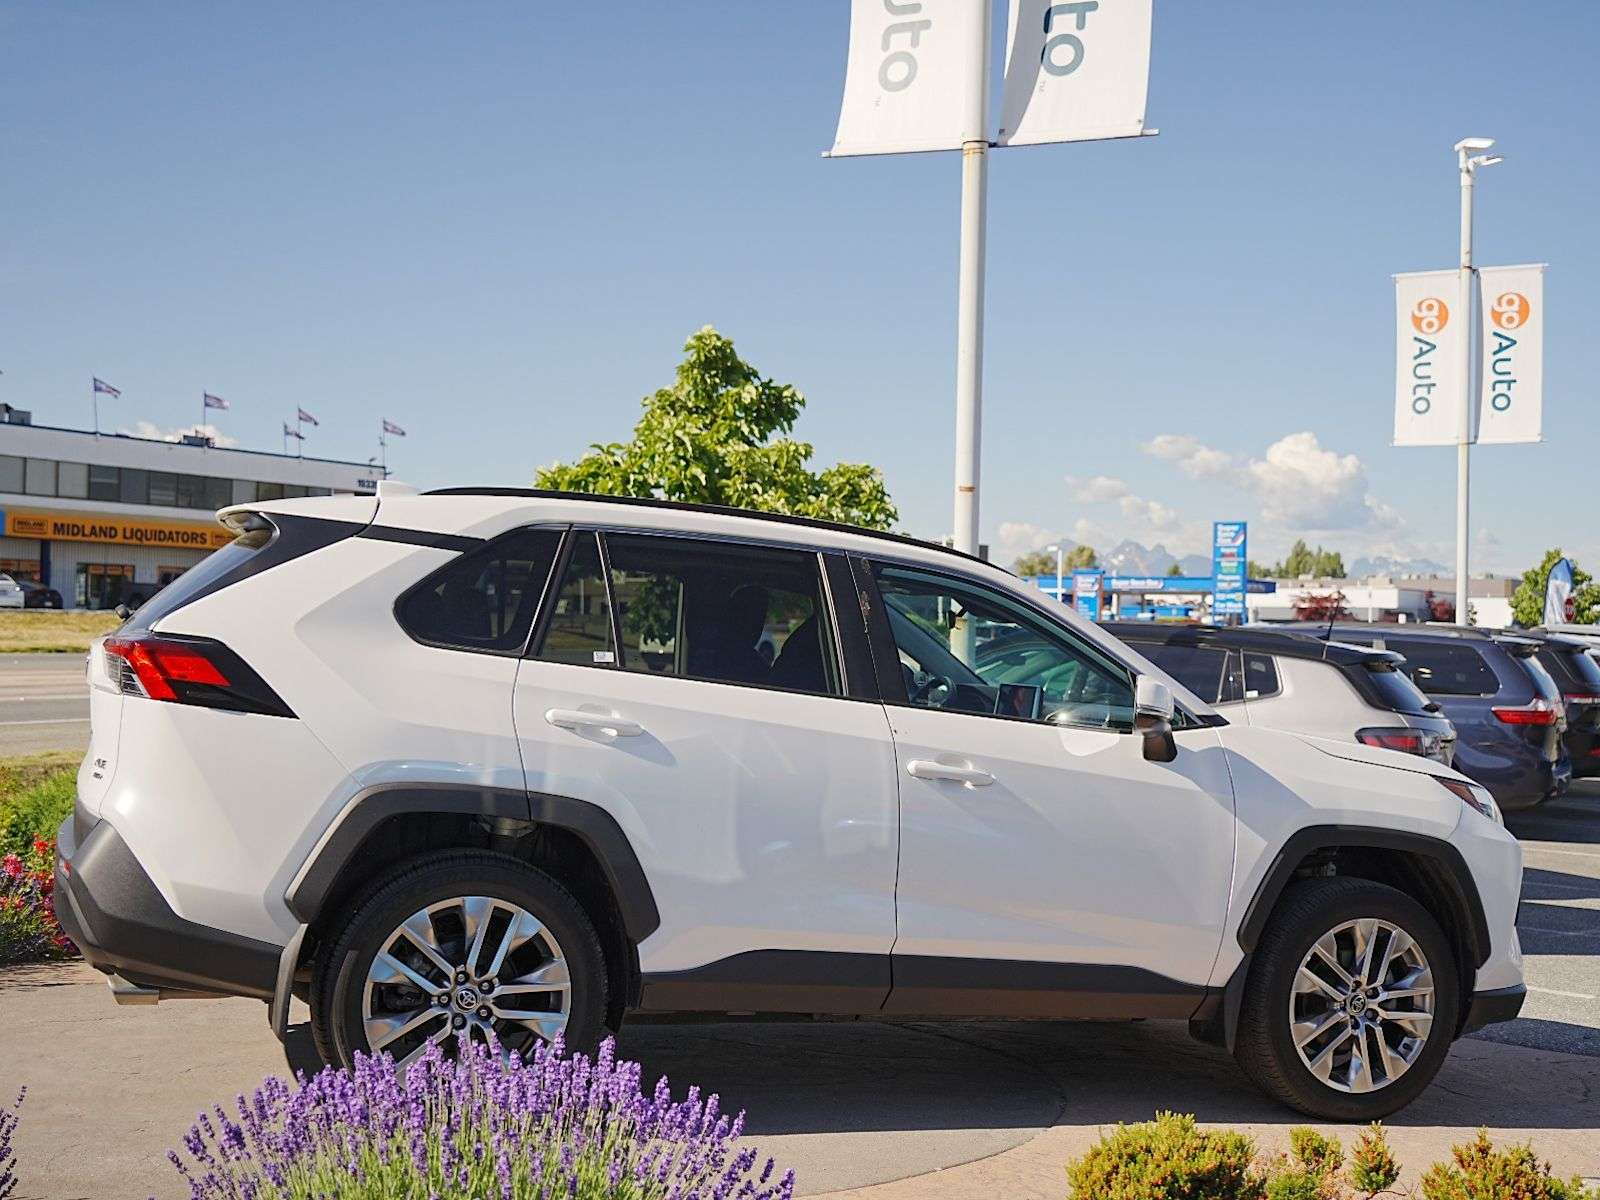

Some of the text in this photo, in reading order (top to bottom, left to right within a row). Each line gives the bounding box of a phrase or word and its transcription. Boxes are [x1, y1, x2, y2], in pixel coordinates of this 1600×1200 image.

[1413, 336, 1437, 414] Auto
[1491, 331, 1518, 411] Auto
[53, 522, 118, 540] MIDLAND
[122, 526, 208, 545] LIQUIDATORS
